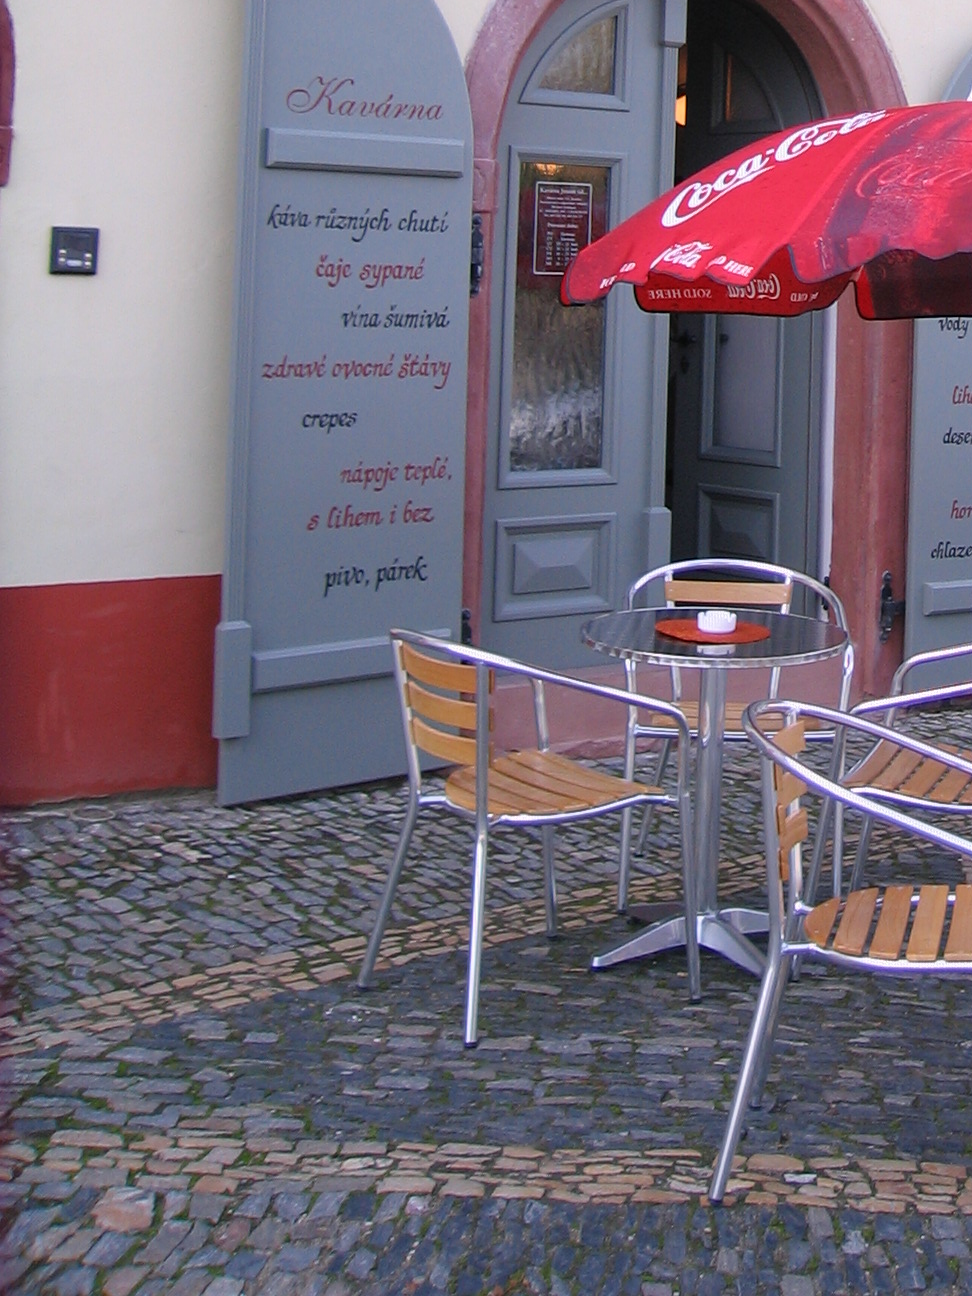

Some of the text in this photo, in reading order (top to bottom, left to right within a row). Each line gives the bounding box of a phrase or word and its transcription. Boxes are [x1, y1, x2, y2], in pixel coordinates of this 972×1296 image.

[286, 76, 444, 120] Kavárna
[267, 204, 450, 243] káva různých chutí
[316, 255, 426, 289] čaje sypané
[723, 260, 754, 279] HERE
[342, 304, 450, 329] vína šumivá
[262, 354, 327, 379] zdravé
[331, 354, 395, 380] ovocné
[302, 412, 358, 435] crepes
[340, 461, 400, 492] nápoje
[306, 500, 435, 531] s lihem i bez
[323, 556, 429, 597] pivo, párek
